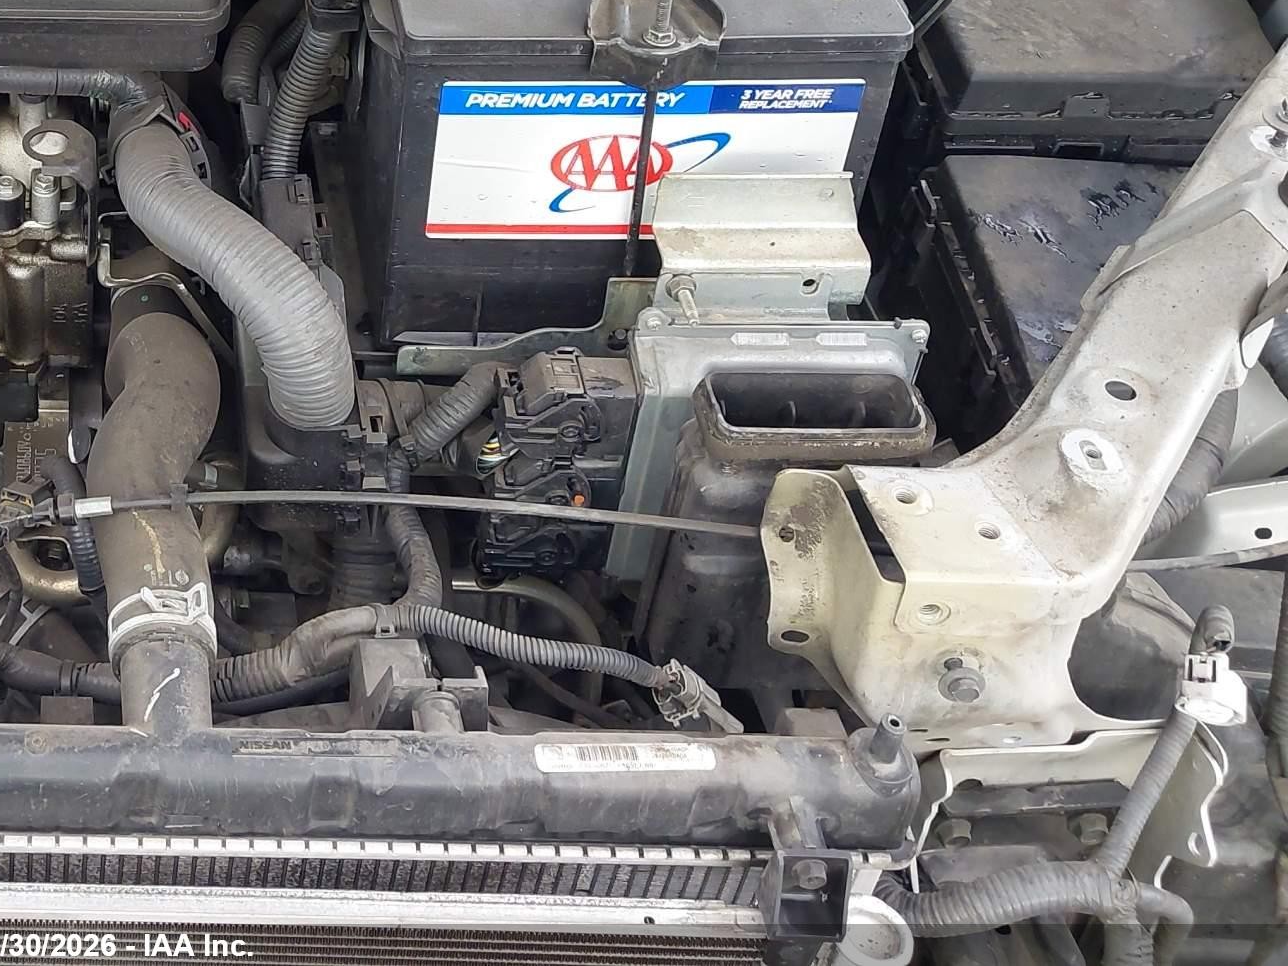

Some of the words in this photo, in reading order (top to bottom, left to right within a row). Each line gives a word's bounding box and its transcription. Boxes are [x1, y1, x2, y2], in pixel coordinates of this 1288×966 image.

[740, 89, 753, 100] 3
[754, 89, 794, 100] YEAR
[794, 88, 835, 100] FREE
[465, 92, 576, 109] PREMIUM
[239, 740, 292, 750] NISSAN
